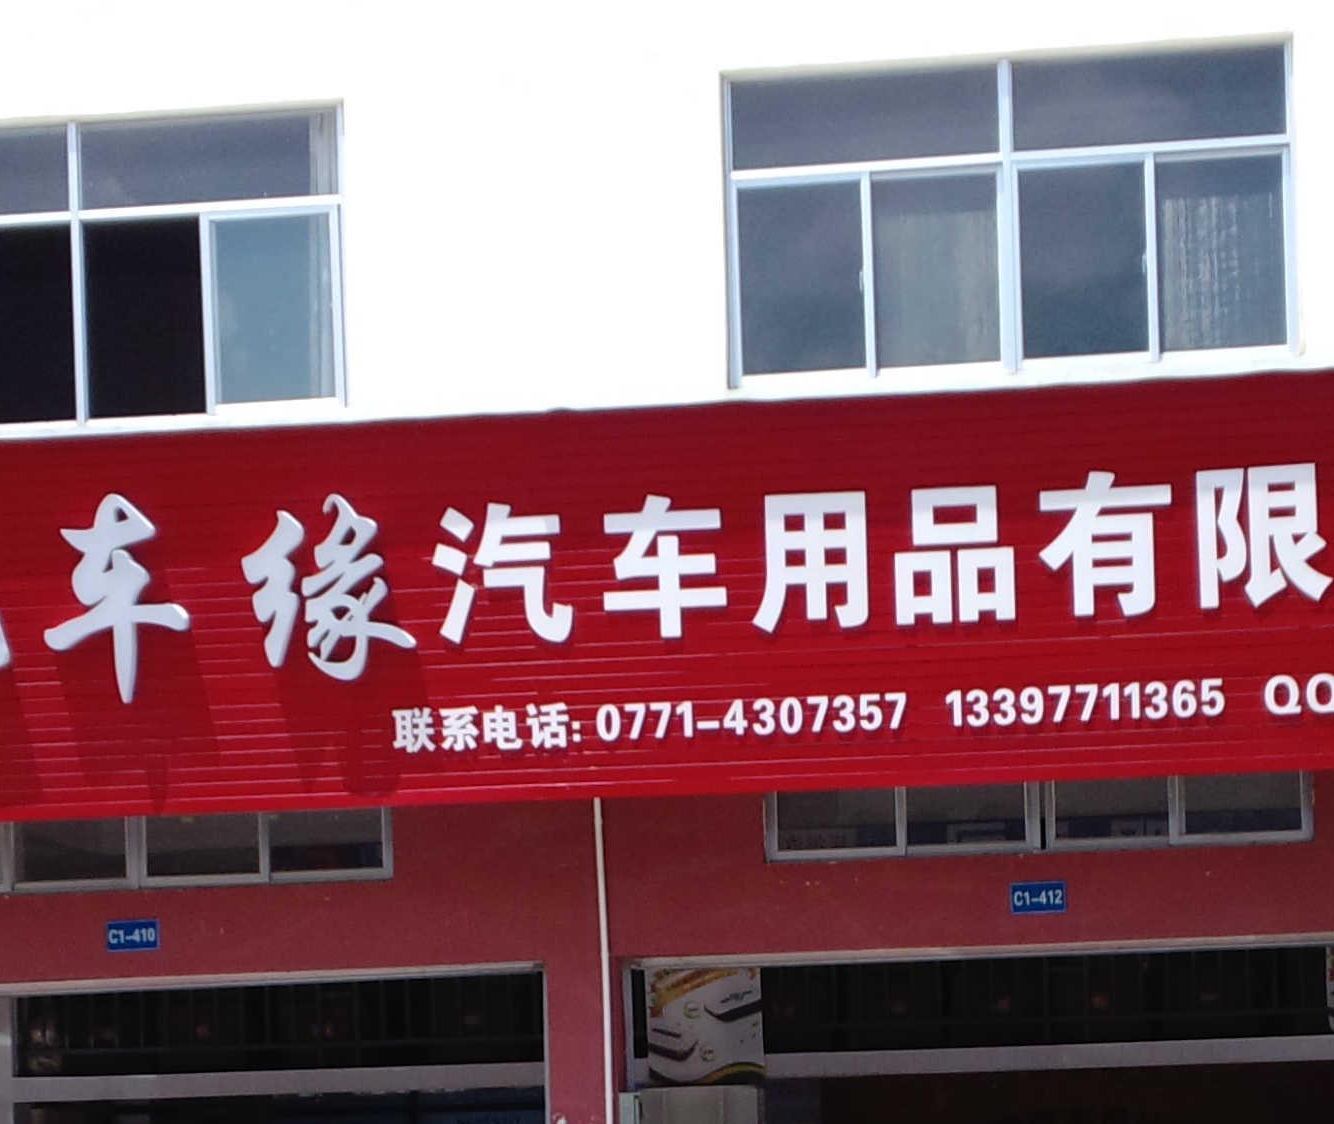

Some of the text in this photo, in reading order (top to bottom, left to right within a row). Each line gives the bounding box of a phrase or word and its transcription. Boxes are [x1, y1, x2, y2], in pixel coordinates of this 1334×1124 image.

[945, 678, 1225, 728] 13397711365
[1013, 889, 1063, 906] C1-412
[108, 928, 156, 944] C1-410
